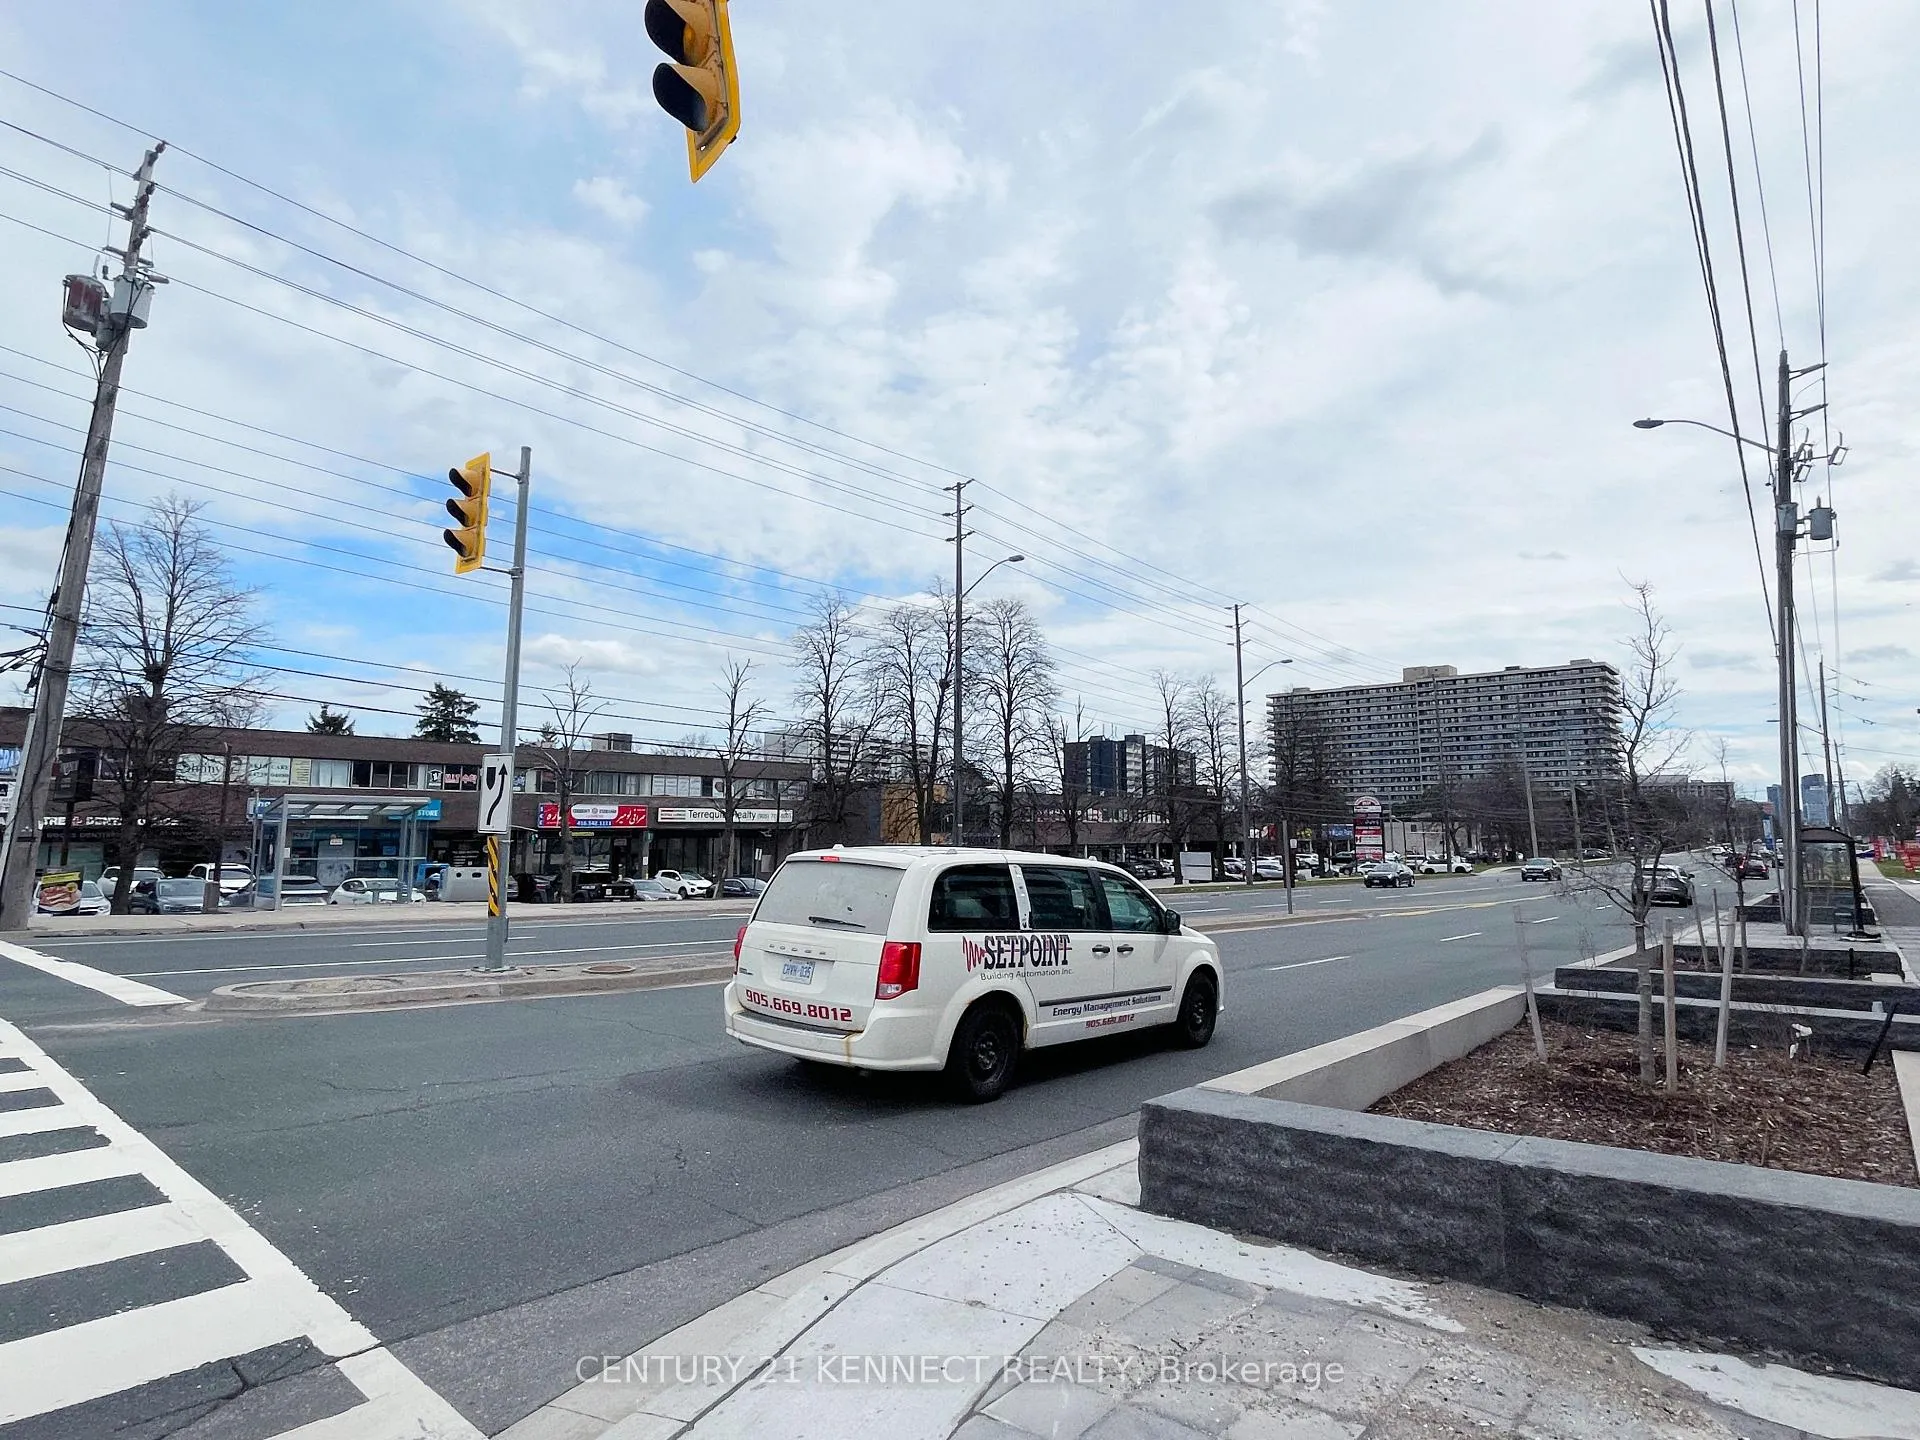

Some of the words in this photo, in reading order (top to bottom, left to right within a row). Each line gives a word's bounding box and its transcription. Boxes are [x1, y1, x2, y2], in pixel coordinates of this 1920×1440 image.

[984, 934, 1070, 970] SETPOINT
[980, 973, 1014, 981] Building
[1015, 969, 1060, 978] Automation
[745, 989, 853, 1022] 905.669.8012
[1052, 1006, 1082, 1017] Energy
[1083, 999, 1131, 1013] Management
[1132, 995, 1161, 1005] Solutions
